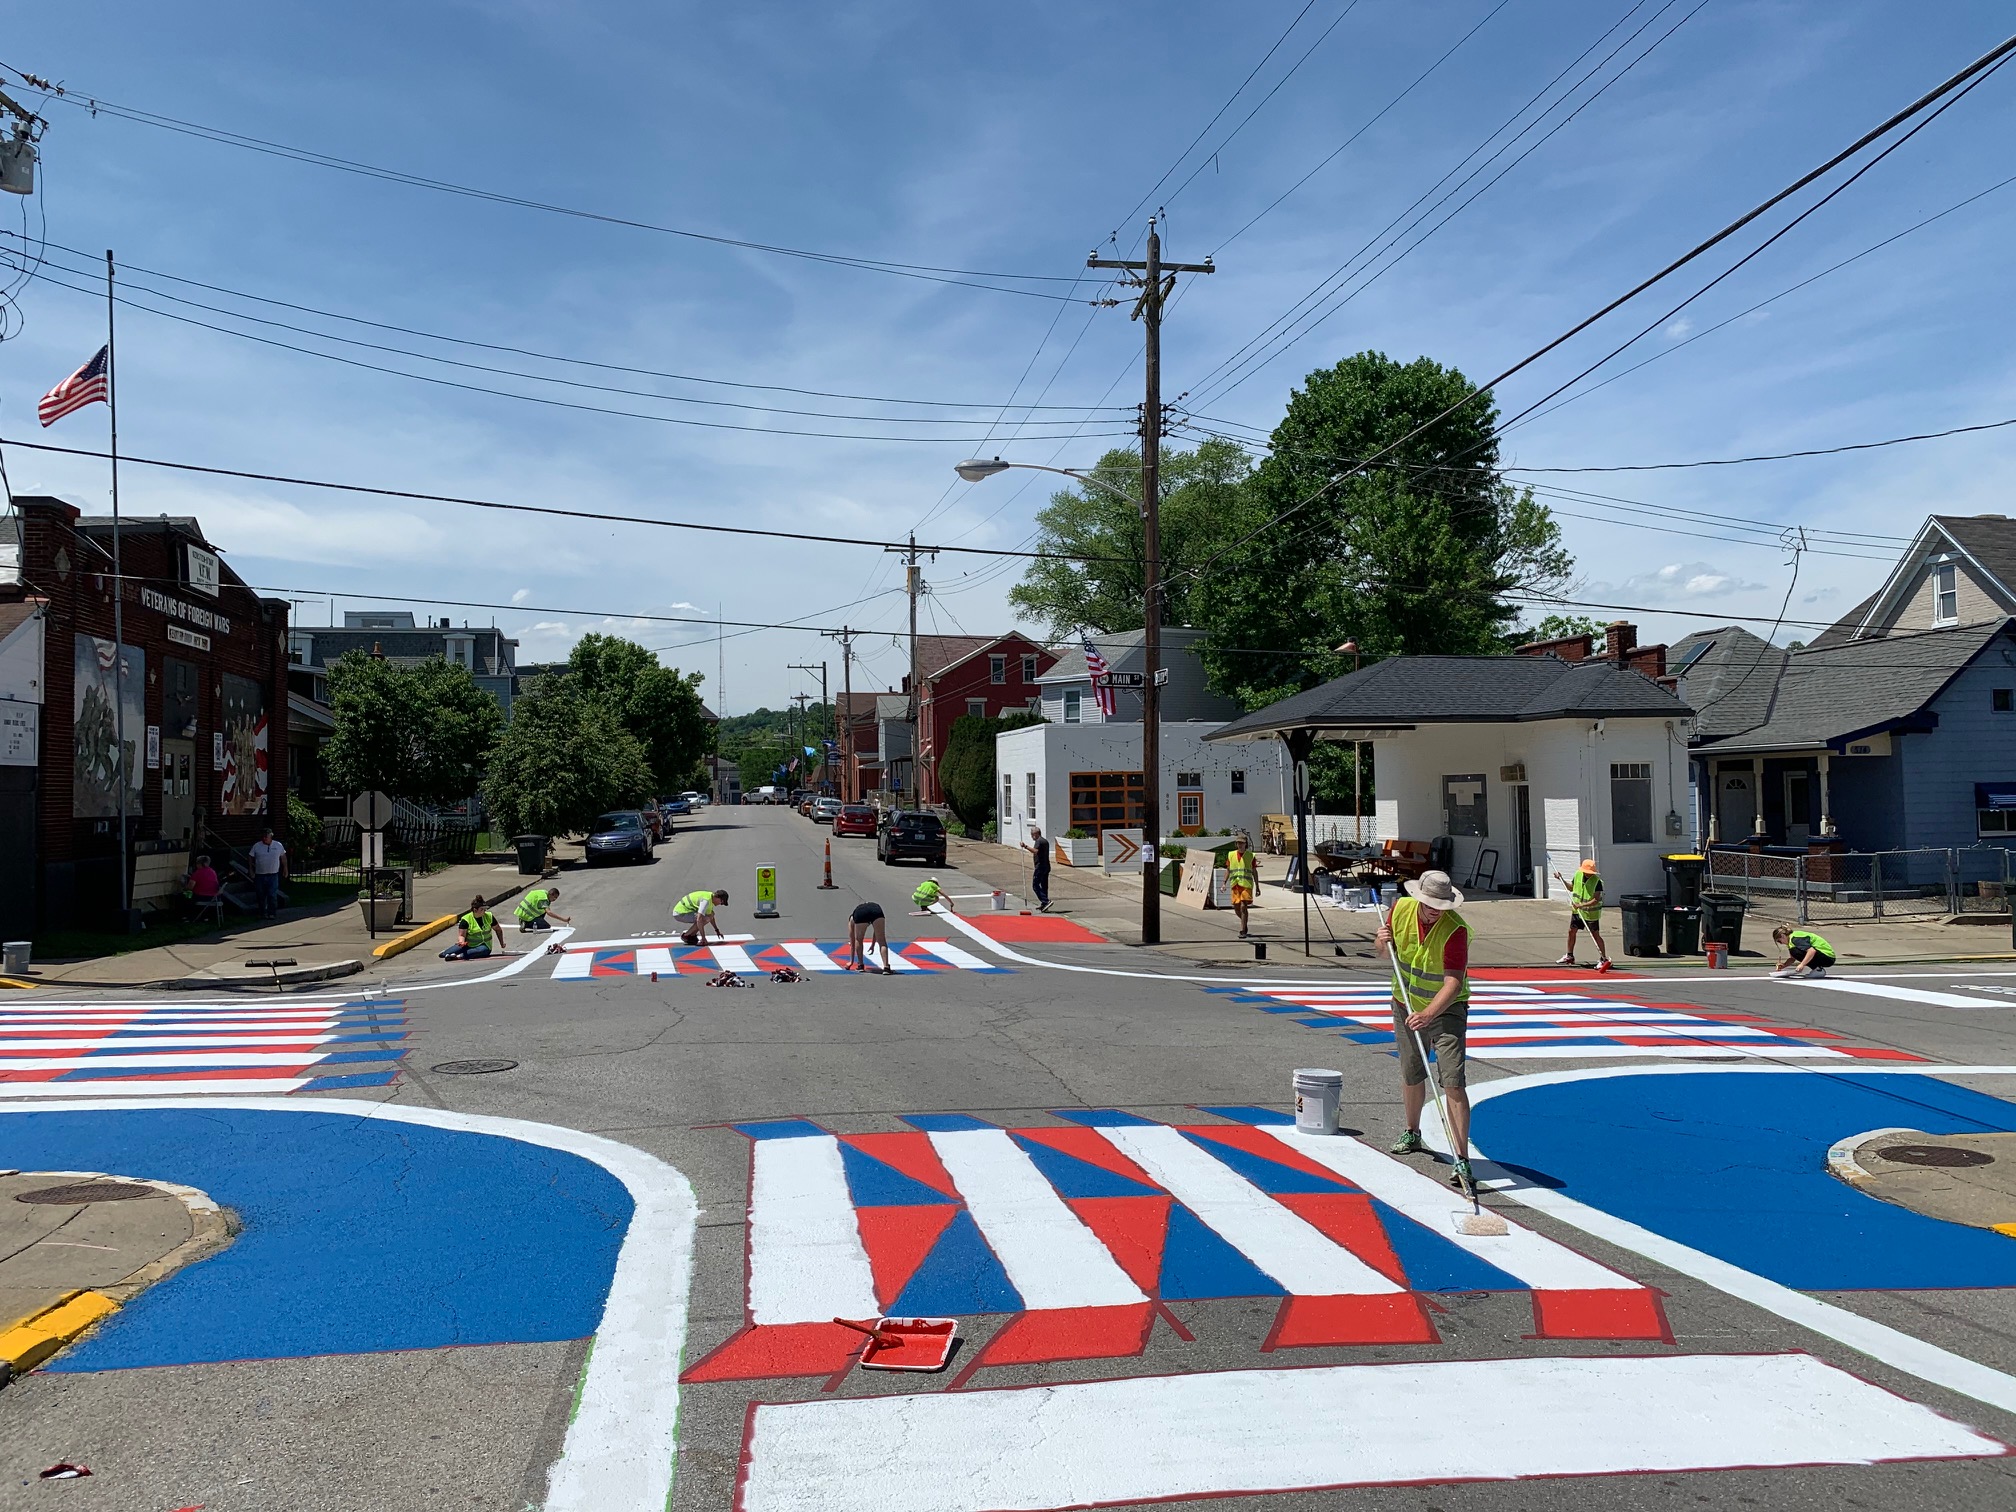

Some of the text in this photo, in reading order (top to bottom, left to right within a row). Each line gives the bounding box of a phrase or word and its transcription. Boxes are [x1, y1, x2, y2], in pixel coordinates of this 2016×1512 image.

[141, 586, 177, 617] VETERANS
[178, 601, 187, 620] OF
[188, 604, 213, 630] FOREIGN
[213, 613, 230, 635] WARS
[1112, 674, 1131, 685] MAIN
